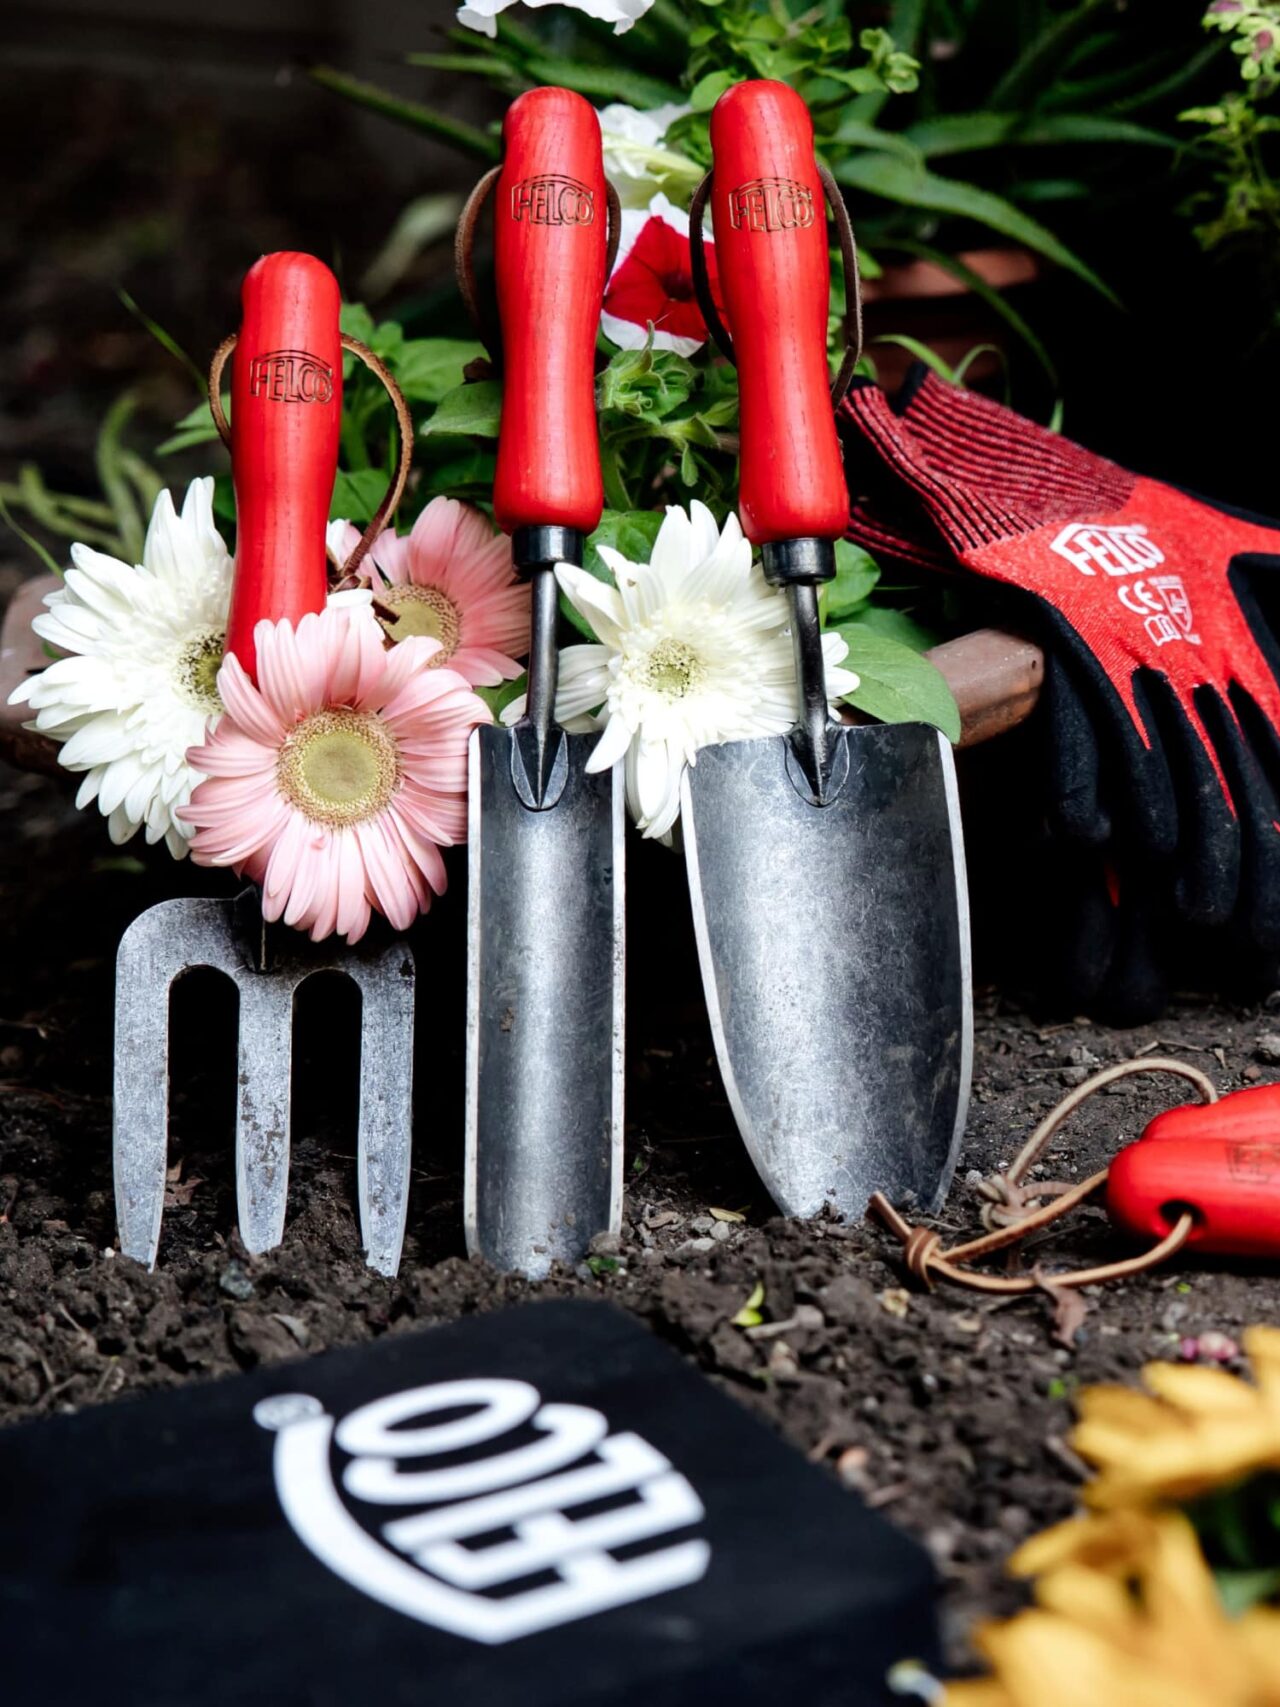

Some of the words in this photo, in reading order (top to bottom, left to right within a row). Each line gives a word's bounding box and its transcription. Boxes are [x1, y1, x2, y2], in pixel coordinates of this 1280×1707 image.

[510, 173, 594, 226] FELCO
[728, 177, 815, 232] FELCO
[250, 349, 332, 403] FELCO
[1050, 523, 1165, 576] FELCO
[1117, 580, 1164, 614] CE
[273, 1378, 711, 1645] FELCO
